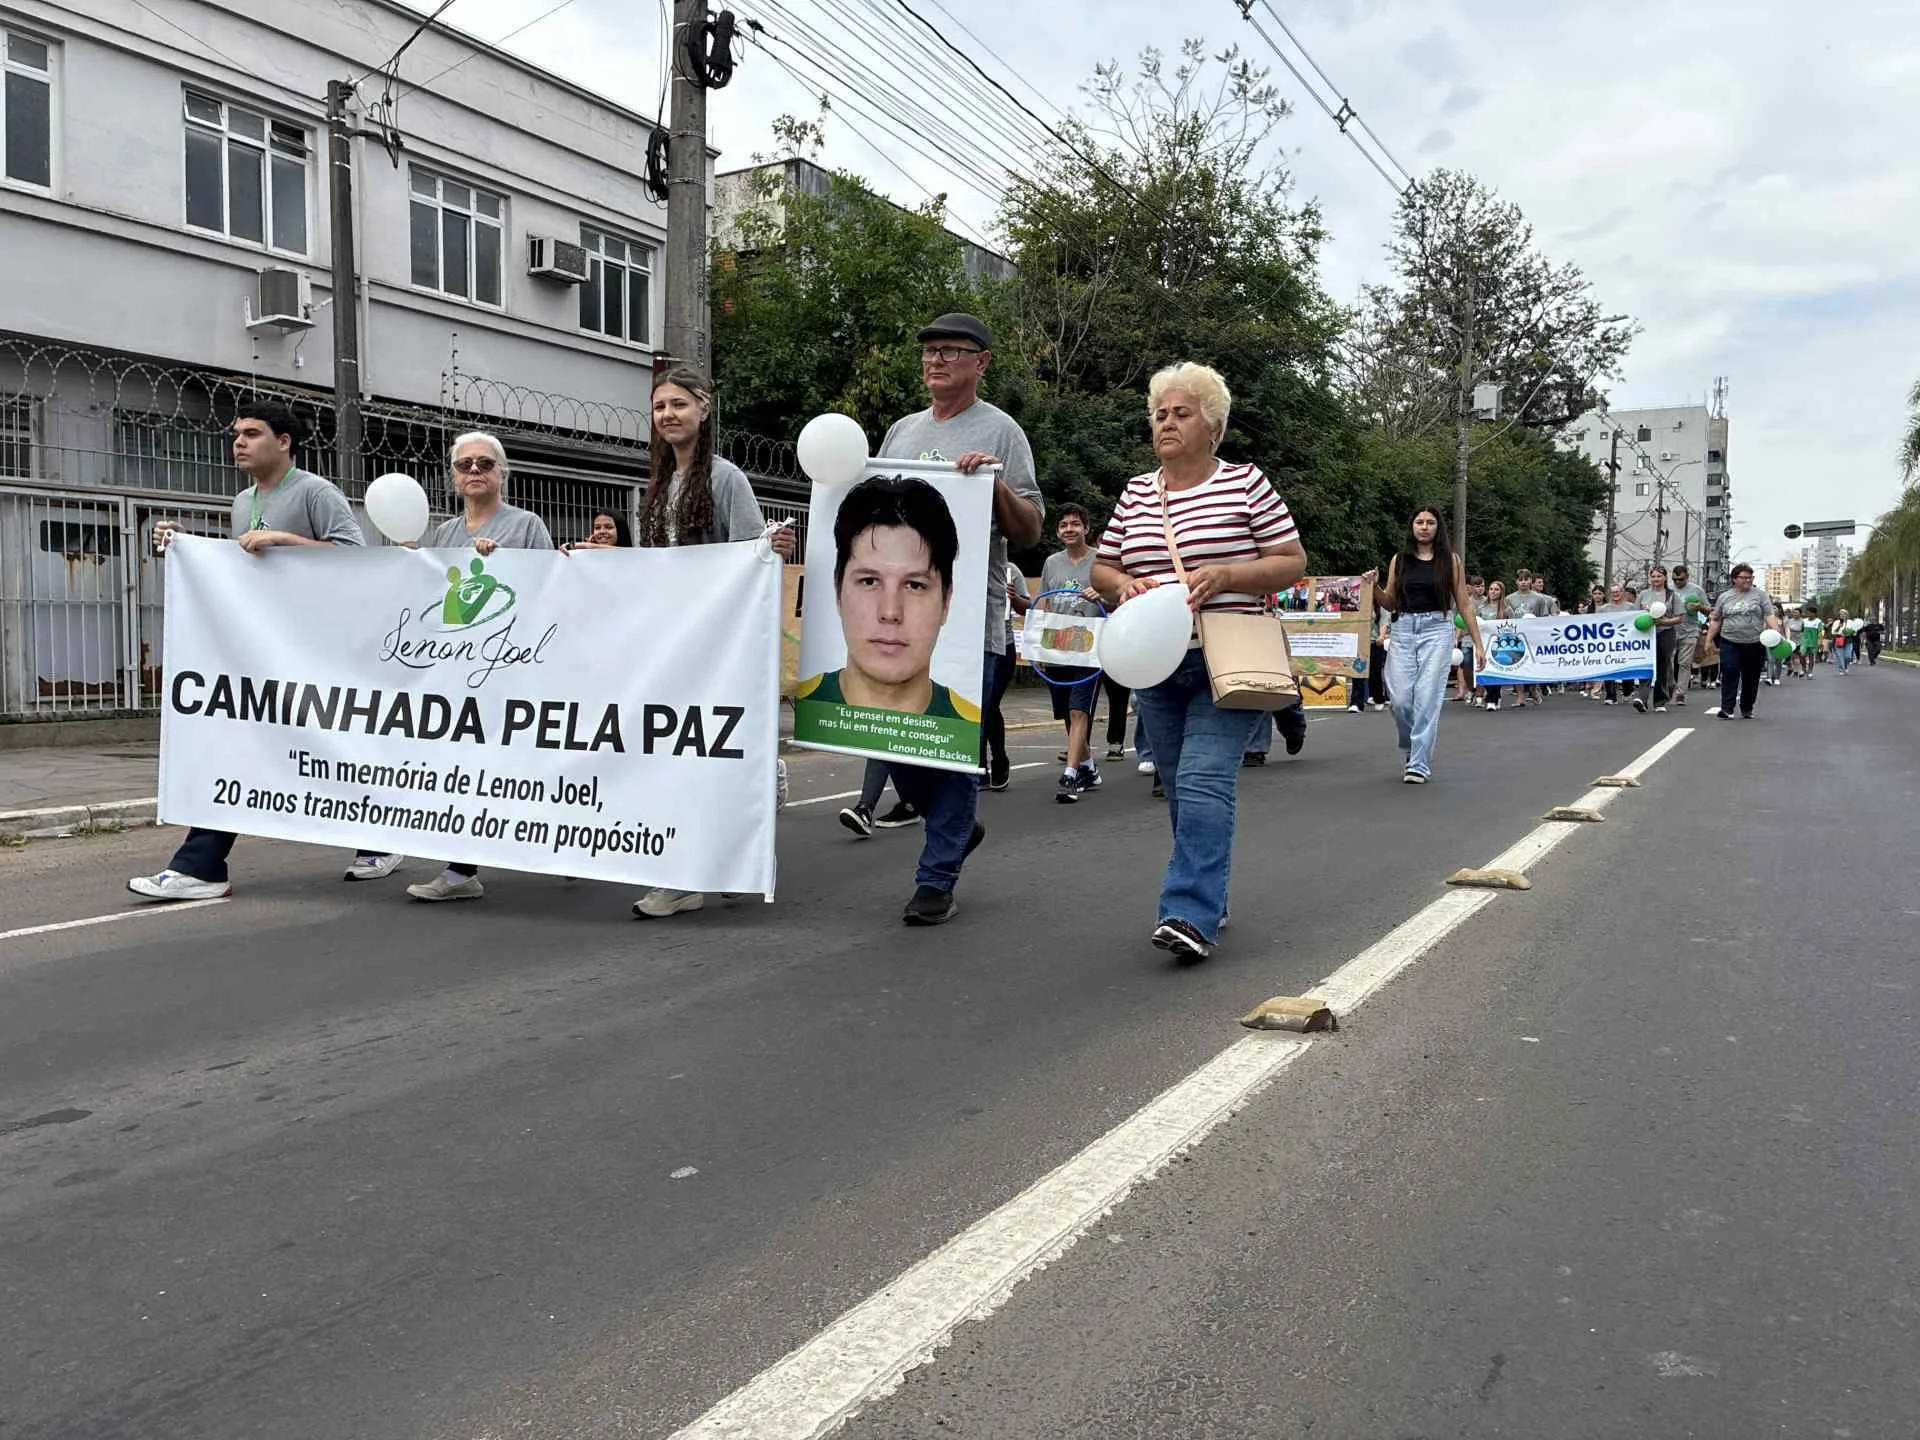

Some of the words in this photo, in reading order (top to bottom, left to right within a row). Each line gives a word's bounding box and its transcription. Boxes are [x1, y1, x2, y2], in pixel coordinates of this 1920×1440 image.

[1564, 622, 1615, 641] ONG
[379, 607, 476, 669] Lenon
[466, 614, 558, 689] Joel
[1536, 643, 1585, 656] AMIGOS
[1588, 642, 1606, 653] DO
[1609, 639, 1651, 652] LENON
[1558, 657, 1580, 667] Porto
[1583, 656, 1601, 666] Vera
[1604, 655, 1626, 664] Cruz
[171, 670, 486, 745] CAMINHADA
[502, 700, 626, 753] PELA
[643, 703, 745, 760] PAZ
[854, 711, 884, 721] pensei
[886, 715, 900, 724] em
[902, 715, 938, 730] desistir,
[818, 720, 838, 729] mas
[840, 720, 851, 730] fui
[854, 724, 868, 732] em
[871, 724, 898, 736] frente
[901, 730, 906, 738] e
[888, 742, 916, 754] Lenon
[918, 746, 937, 757] Joel
[940, 749, 972, 762] Backes
[337, 758, 438, 794] memória
[444, 765, 471, 796] de
[477, 769, 545, 802] Lenon
[550, 775, 604, 813] Joel,
[213, 779, 242, 806] 20
[246, 788, 298, 814] anos
[304, 791, 465, 835] transformando
[471, 808, 510, 839] dor
[514, 820, 549, 844] em
